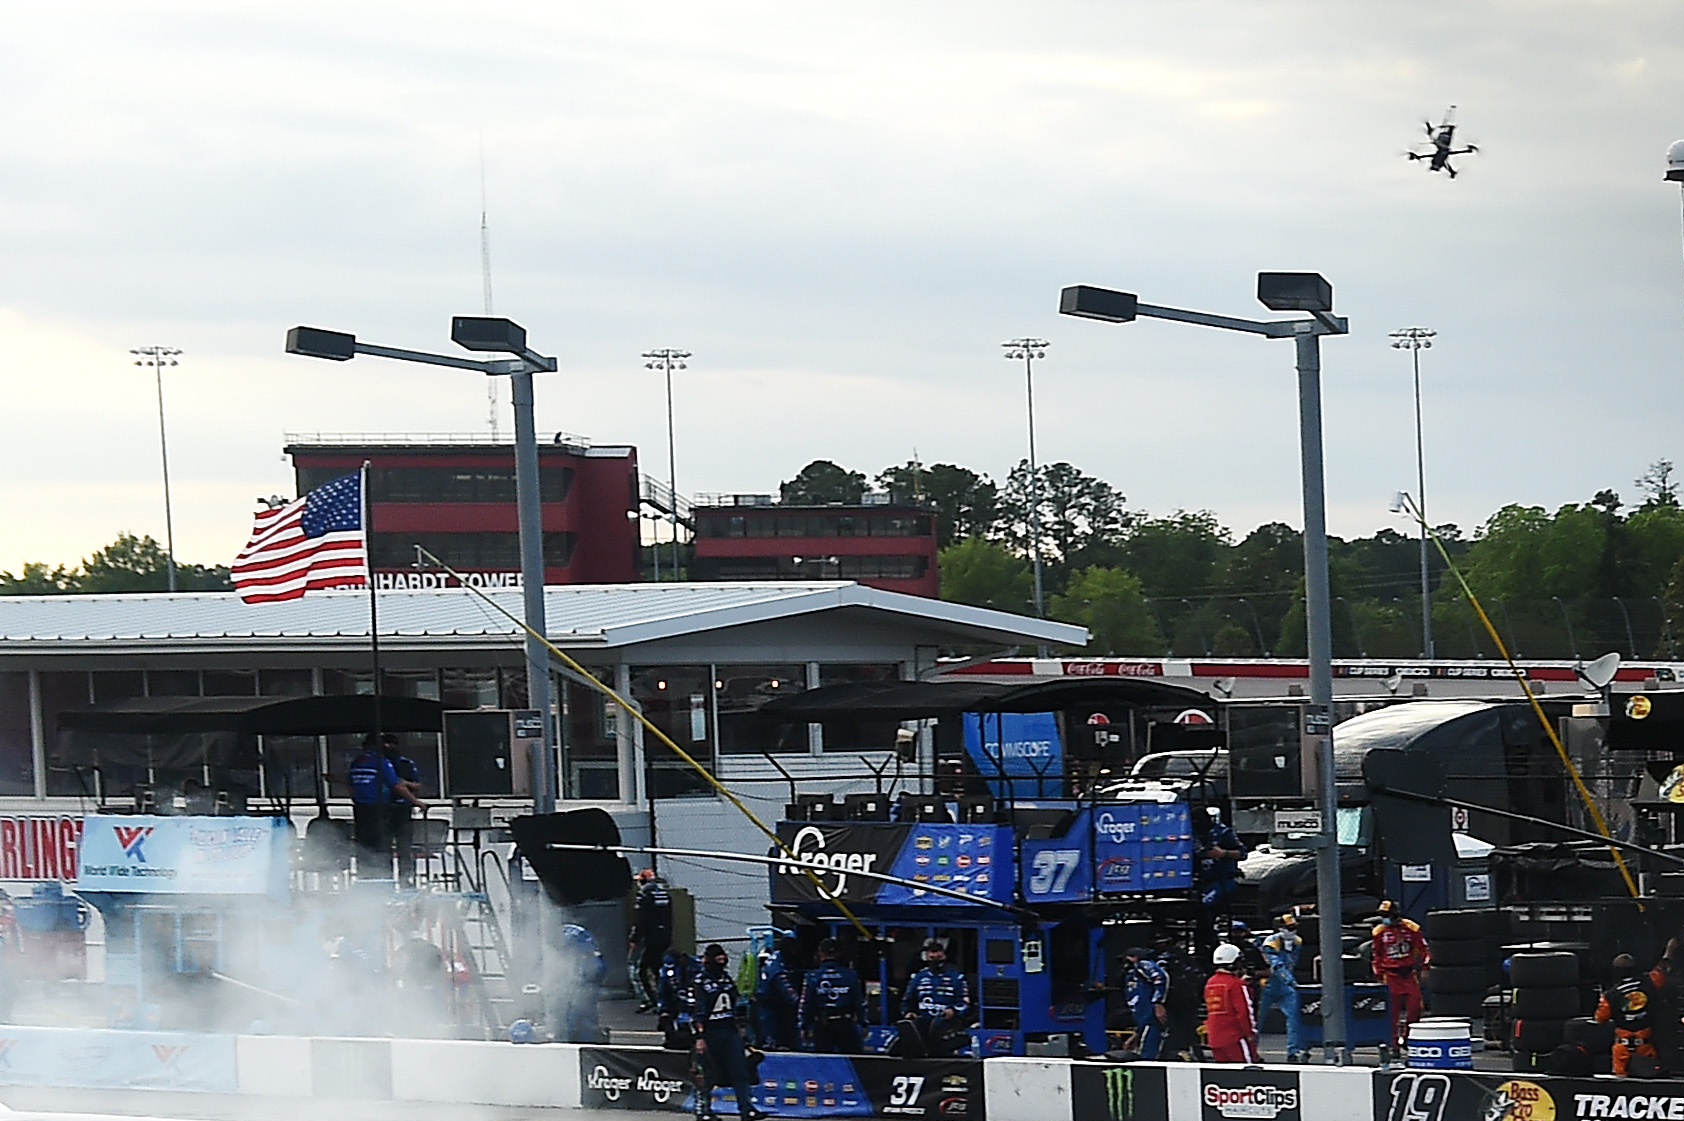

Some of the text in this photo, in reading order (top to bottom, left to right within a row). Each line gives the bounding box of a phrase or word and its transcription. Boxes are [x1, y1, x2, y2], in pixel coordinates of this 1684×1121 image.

[460, 573, 525, 588] TOWE
[1096, 812, 1136, 843] Kroger
[778, 826, 878, 900] Kroger
[1029, 849, 1080, 894] 37
[588, 1064, 631, 1101] Kroger
[637, 1066, 683, 1102] Kroger
[890, 1075, 925, 1106] 37
[1510, 1082, 1539, 1101] Bass
[1510, 1101, 1533, 1117] Pro
